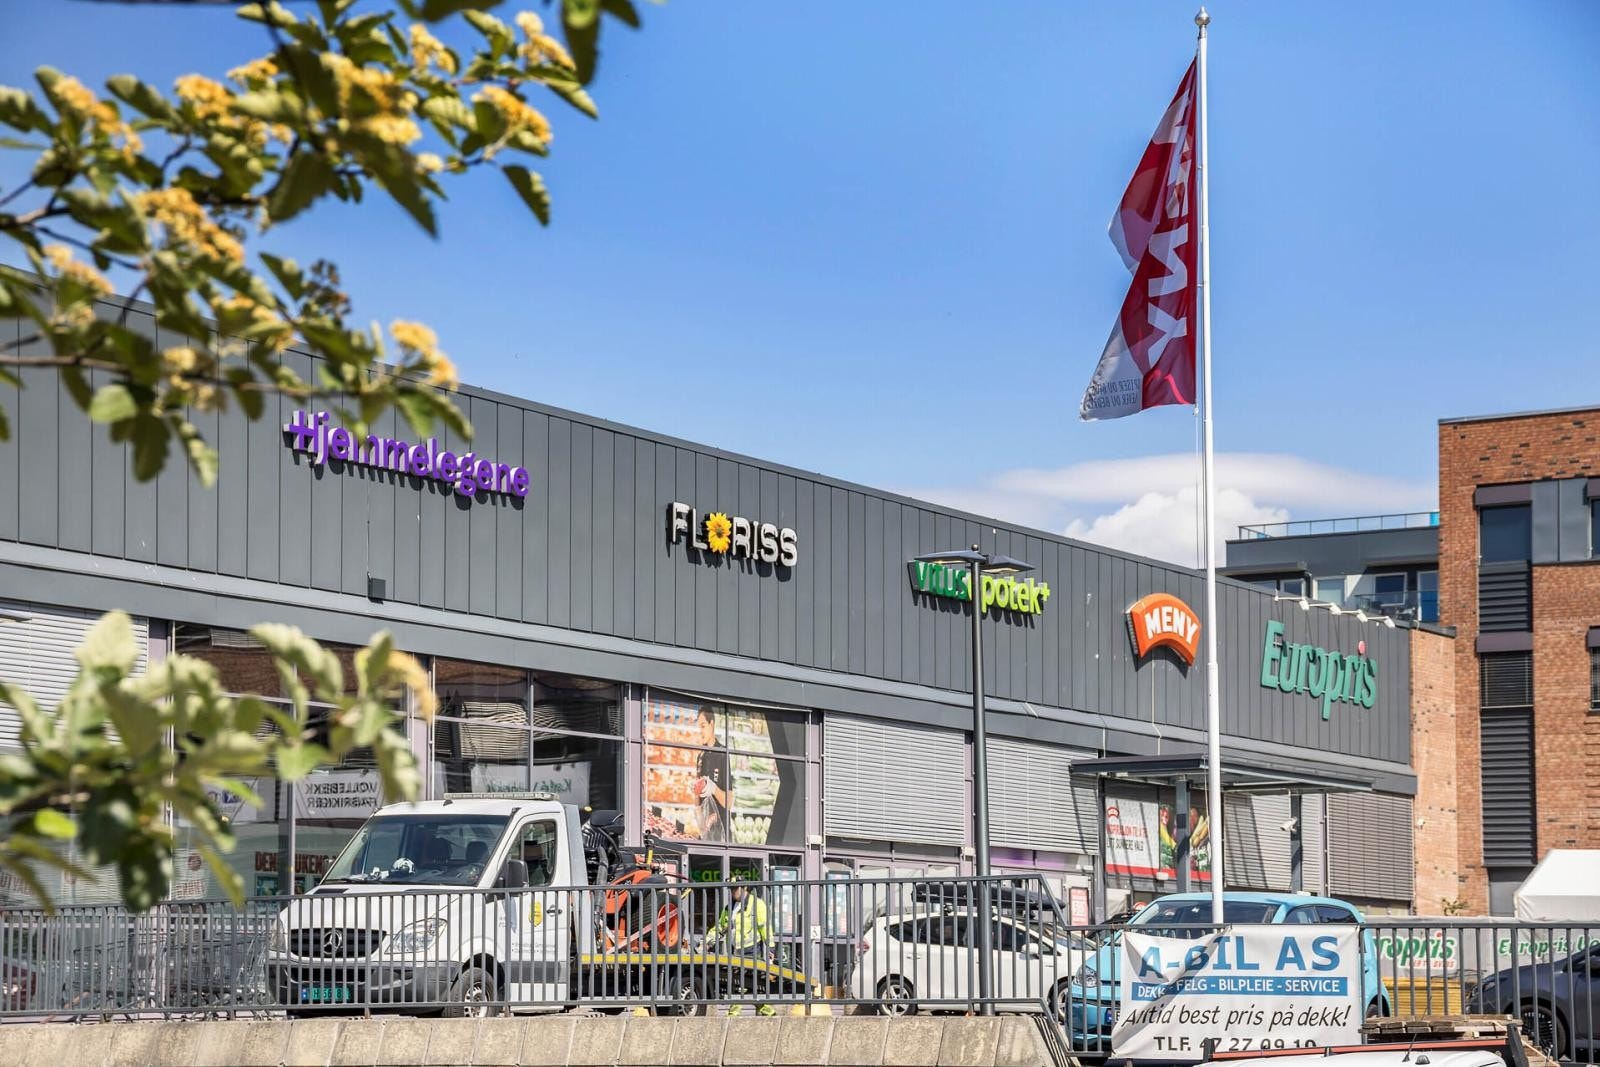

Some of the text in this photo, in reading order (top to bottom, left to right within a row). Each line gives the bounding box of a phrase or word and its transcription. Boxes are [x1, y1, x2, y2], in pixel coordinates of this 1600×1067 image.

[284, 410, 530, 497] Hjemmelegene
[671, 502, 798, 567] FLORISS
[1144, 606, 1200, 645] MENY
[1261, 620, 1379, 720] Europris
[1138, 935, 1340, 979] A-BIL AS
[1372, 932, 1455, 966] ropris
[1176, 979, 1208, 992] FELG
[1218, 979, 1274, 992] BILPLEIE
[1285, 980, 1340, 993] SERVICE
[1179, 1004, 1221, 1025] best
[1225, 1005, 1263, 1031] pris
[1269, 1004, 1295, 1032] på
[1297, 1004, 1352, 1027] dekk!
[1154, 1037, 1191, 1051] TLF.
[1229, 1037, 1253, 1051] 27
